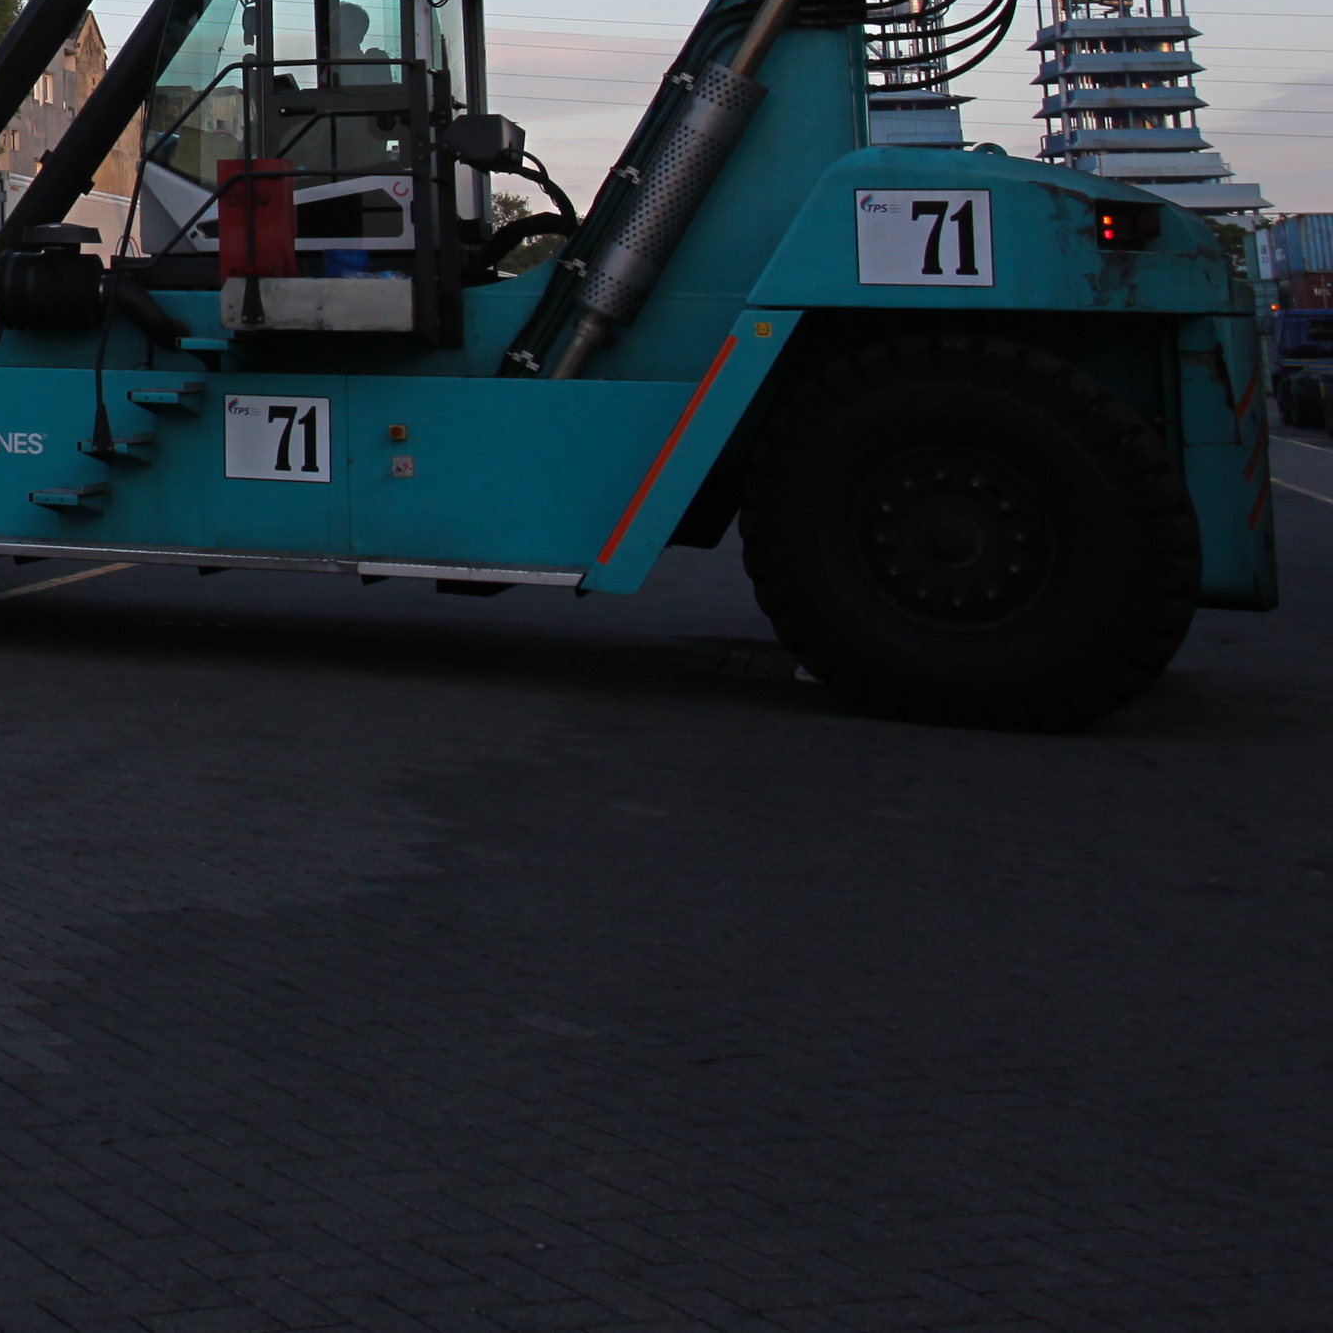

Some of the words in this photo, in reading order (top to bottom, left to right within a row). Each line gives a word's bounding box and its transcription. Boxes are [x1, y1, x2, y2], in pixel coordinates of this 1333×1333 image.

[867, 203, 888, 213] TPS
[911, 199, 979, 275] 71
[233, 406, 250, 416] TPS
[267, 405, 320, 473] 71
